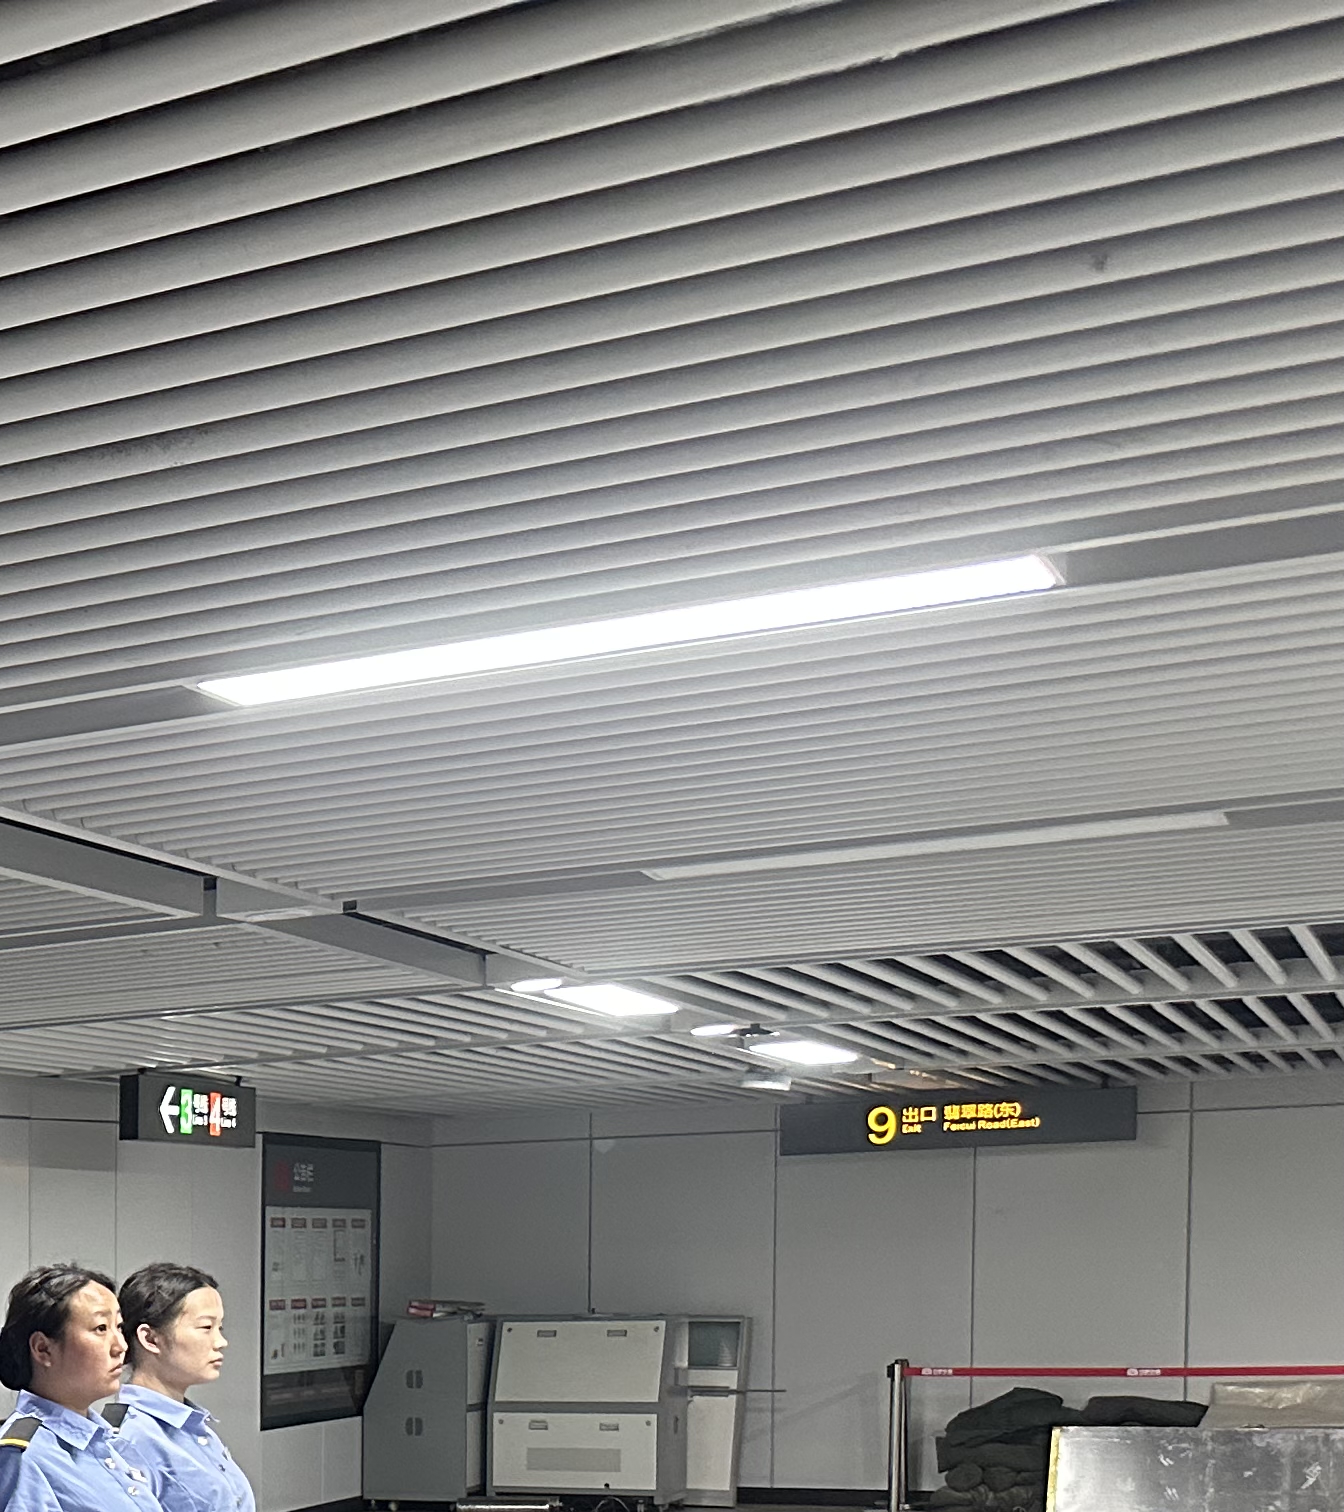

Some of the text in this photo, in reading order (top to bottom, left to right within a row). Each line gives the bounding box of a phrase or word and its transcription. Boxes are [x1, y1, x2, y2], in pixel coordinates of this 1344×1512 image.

[180, 1093, 192, 1131] 3
[209, 1096, 221, 1134] 4
[867, 1106, 898, 1145] 9
[901, 1106, 937, 1123] 出口
